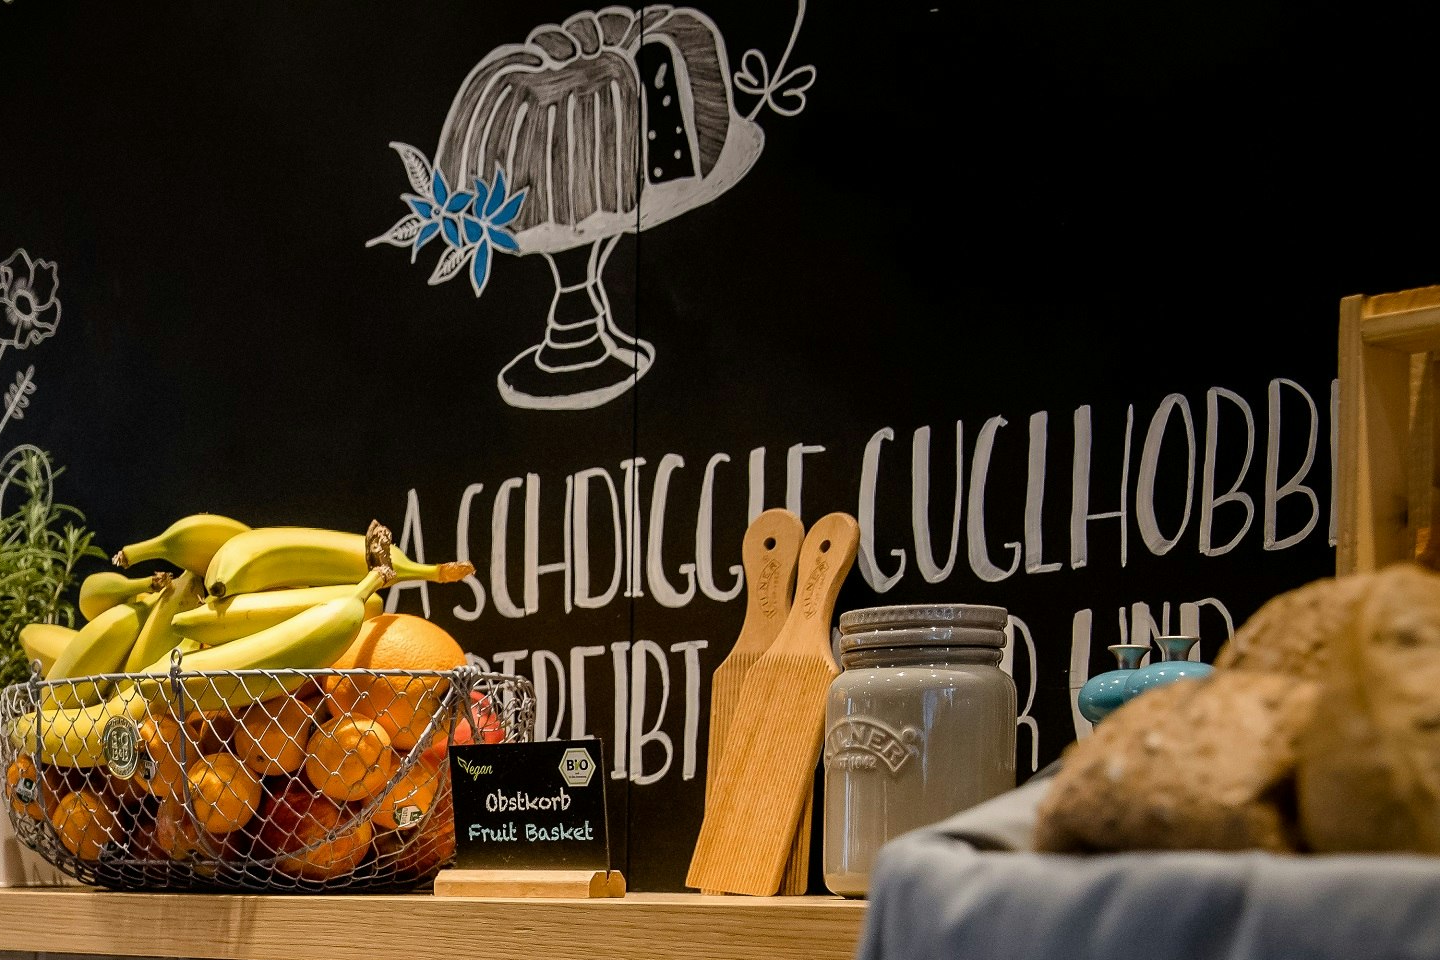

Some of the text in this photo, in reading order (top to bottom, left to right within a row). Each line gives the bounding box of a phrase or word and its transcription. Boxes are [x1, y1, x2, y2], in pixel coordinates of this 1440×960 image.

[457, 756, 494, 782] Vegan
[485, 786, 572, 812] Obstkorb
[468, 820, 594, 843] Fruit Basket
